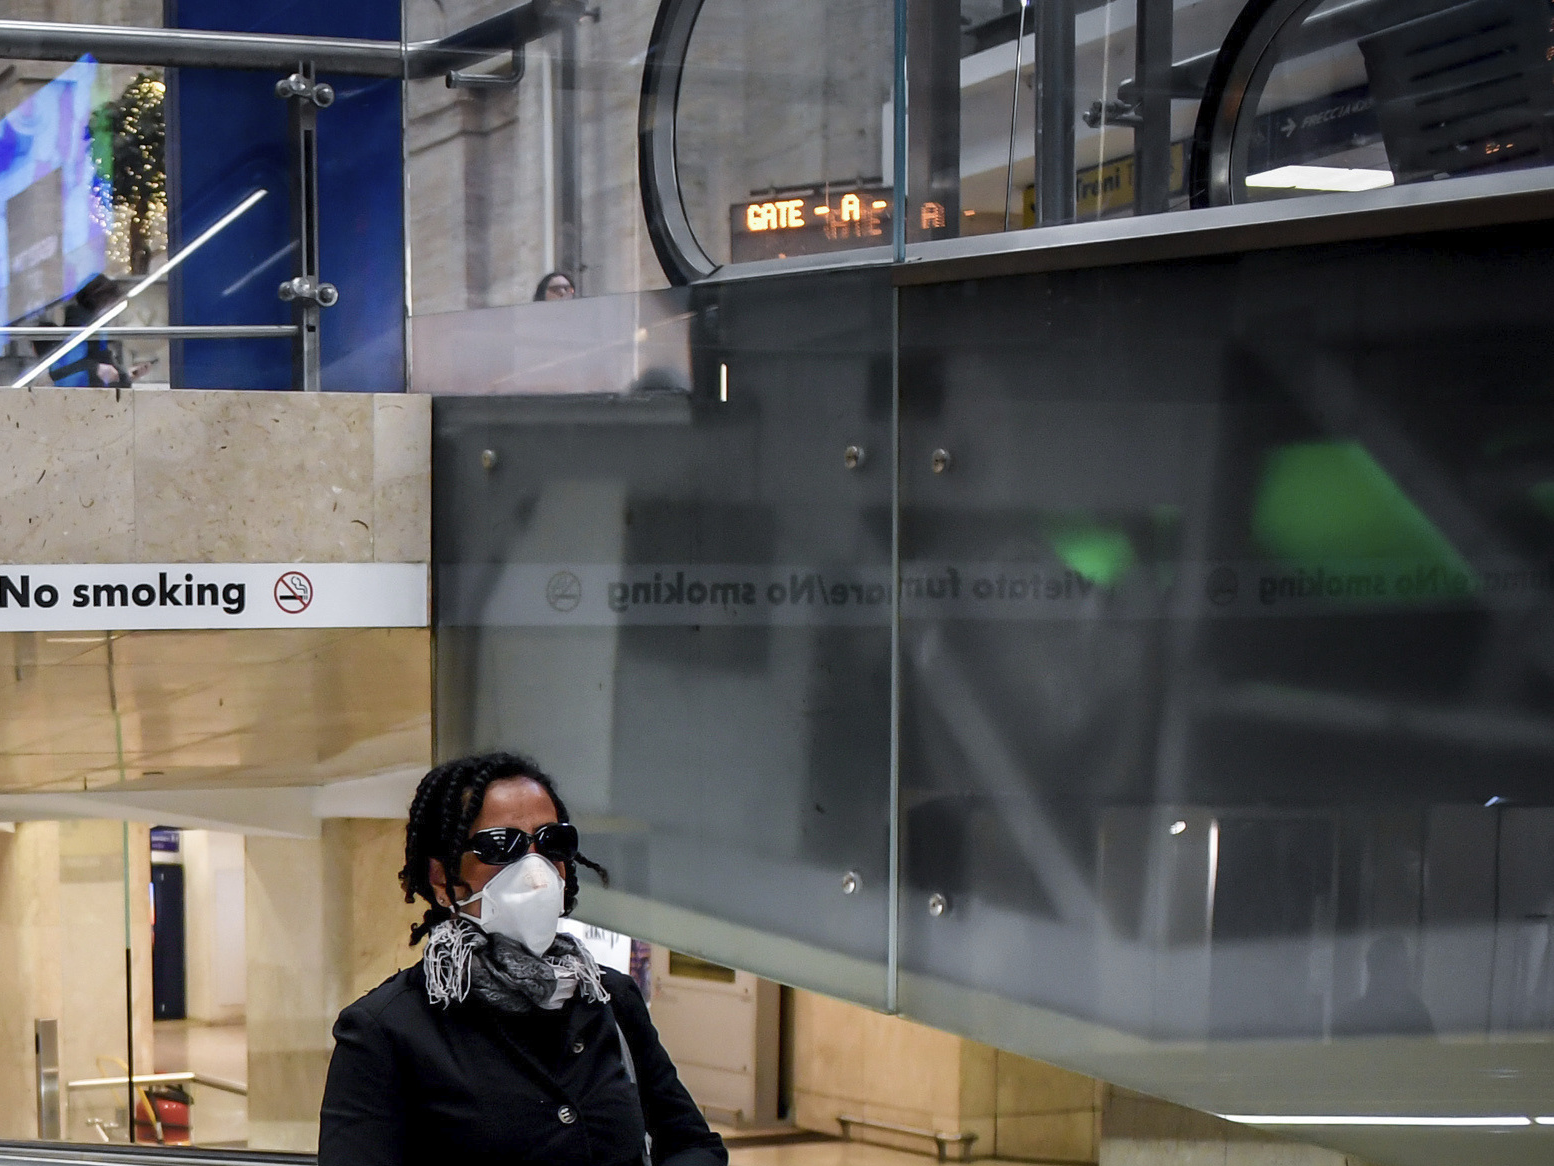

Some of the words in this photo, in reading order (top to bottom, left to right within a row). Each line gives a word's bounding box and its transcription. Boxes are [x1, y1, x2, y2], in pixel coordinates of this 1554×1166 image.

[747, 199, 805, 231] GATE
[841, 193, 860, 222] A
[72, 572, 246, 615] smoking
